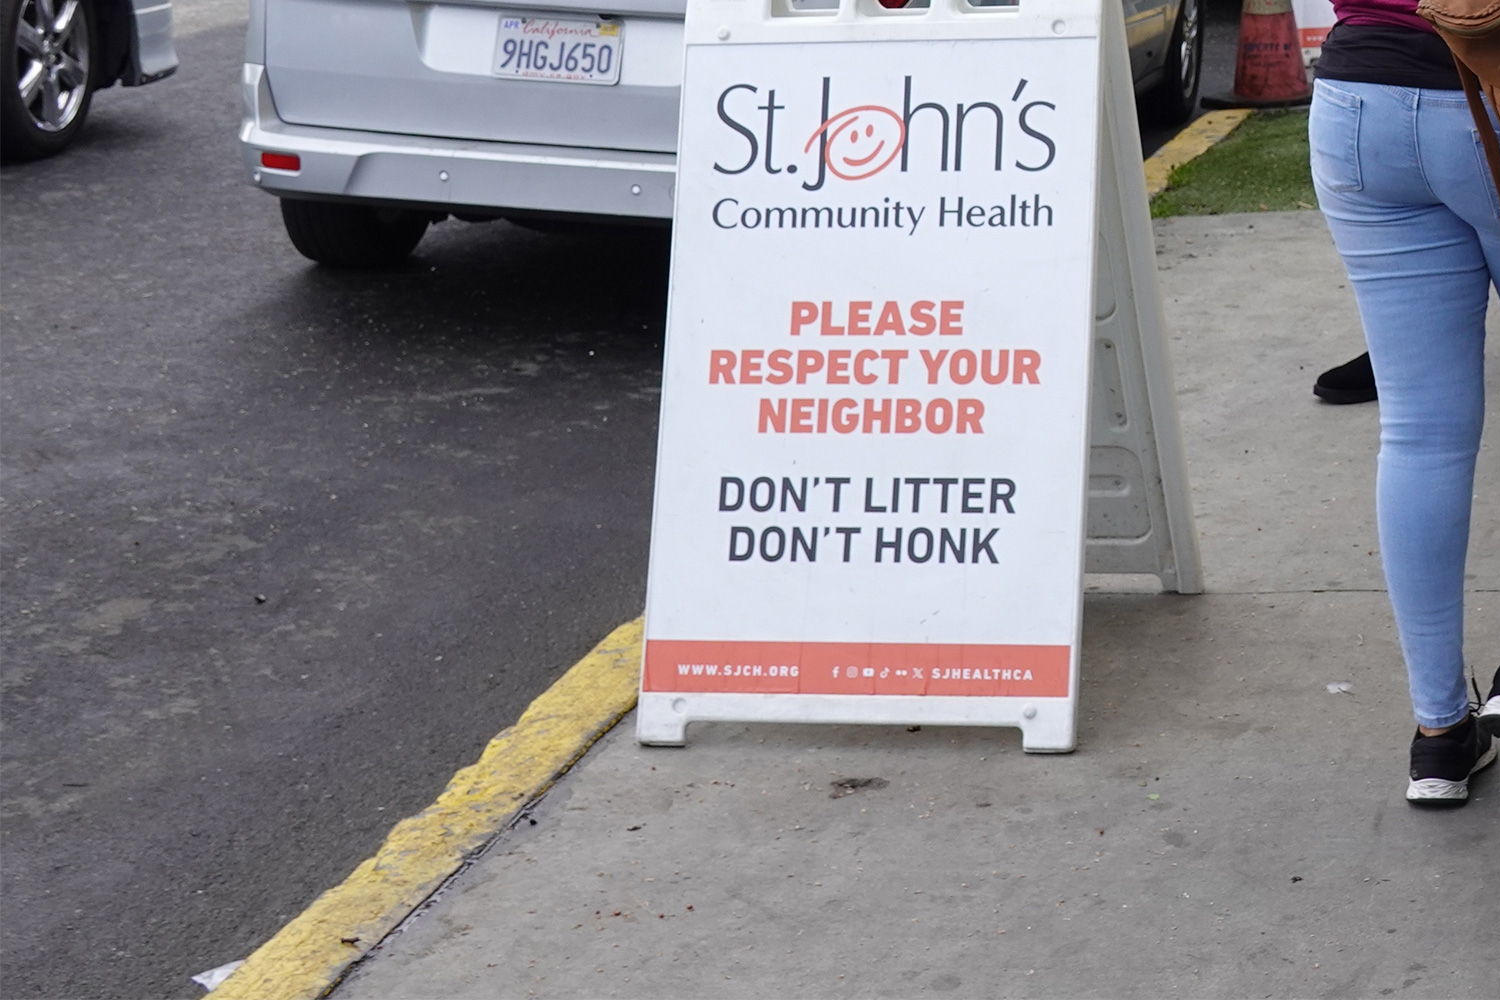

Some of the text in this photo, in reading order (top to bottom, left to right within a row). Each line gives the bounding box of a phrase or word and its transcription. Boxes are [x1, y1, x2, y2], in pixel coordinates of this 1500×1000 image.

[503, 20, 520, 30] APR
[523, 18, 600, 40] California
[500, 38, 613, 75] 9HGJ650
[713, 75, 1057, 191] St. John's
[712, 194, 1054, 236] Community Health
[790, 300, 965, 336] PLEASE
[708, 349, 1042, 385] RESPECT YOUR
[757, 398, 986, 434] NEIGHBOR
[718, 476, 1017, 514] DON'T LITTER
[728, 526, 1001, 564] DON'T HONK
[677, 663, 1034, 681] WWW.SJCH.ORG SJHEALTHCA
